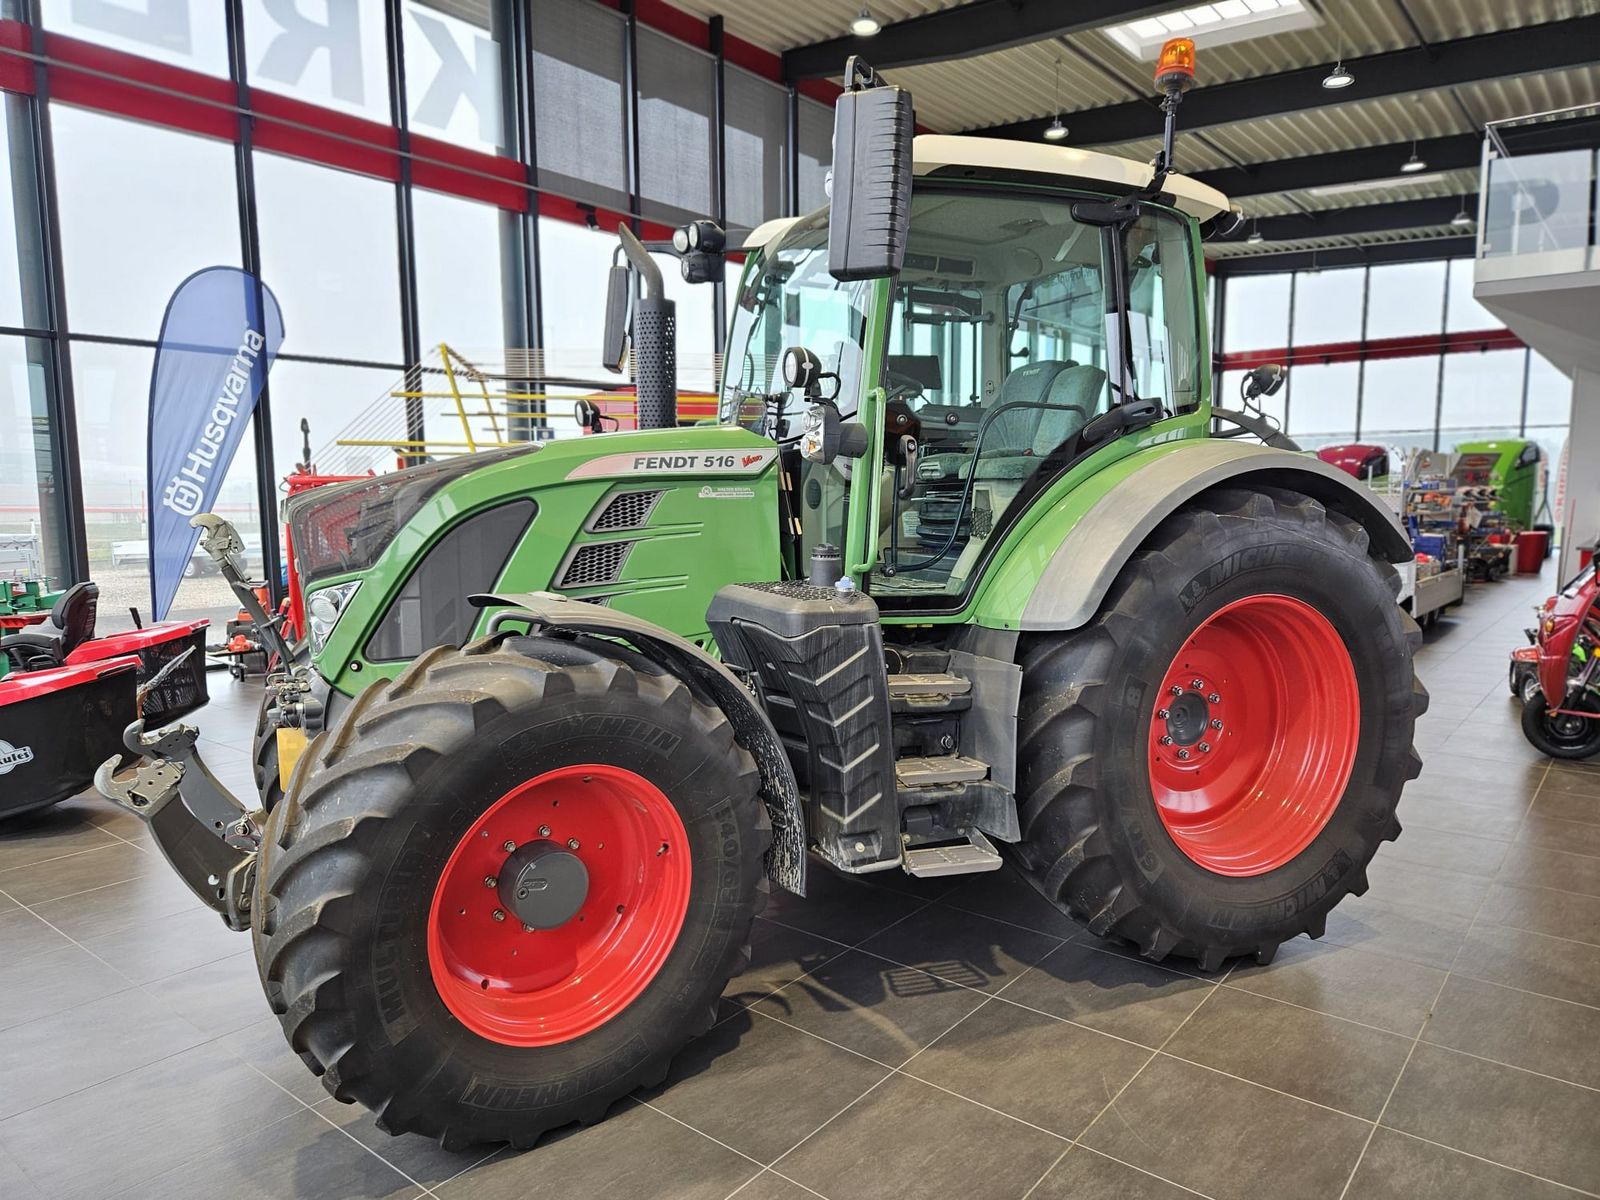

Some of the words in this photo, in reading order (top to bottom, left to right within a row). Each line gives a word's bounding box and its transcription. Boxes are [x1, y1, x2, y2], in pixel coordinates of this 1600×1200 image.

[181, 328, 265, 483] Husqvarna
[633, 456, 698, 470] FENDT
[703, 456, 735, 467] 516
